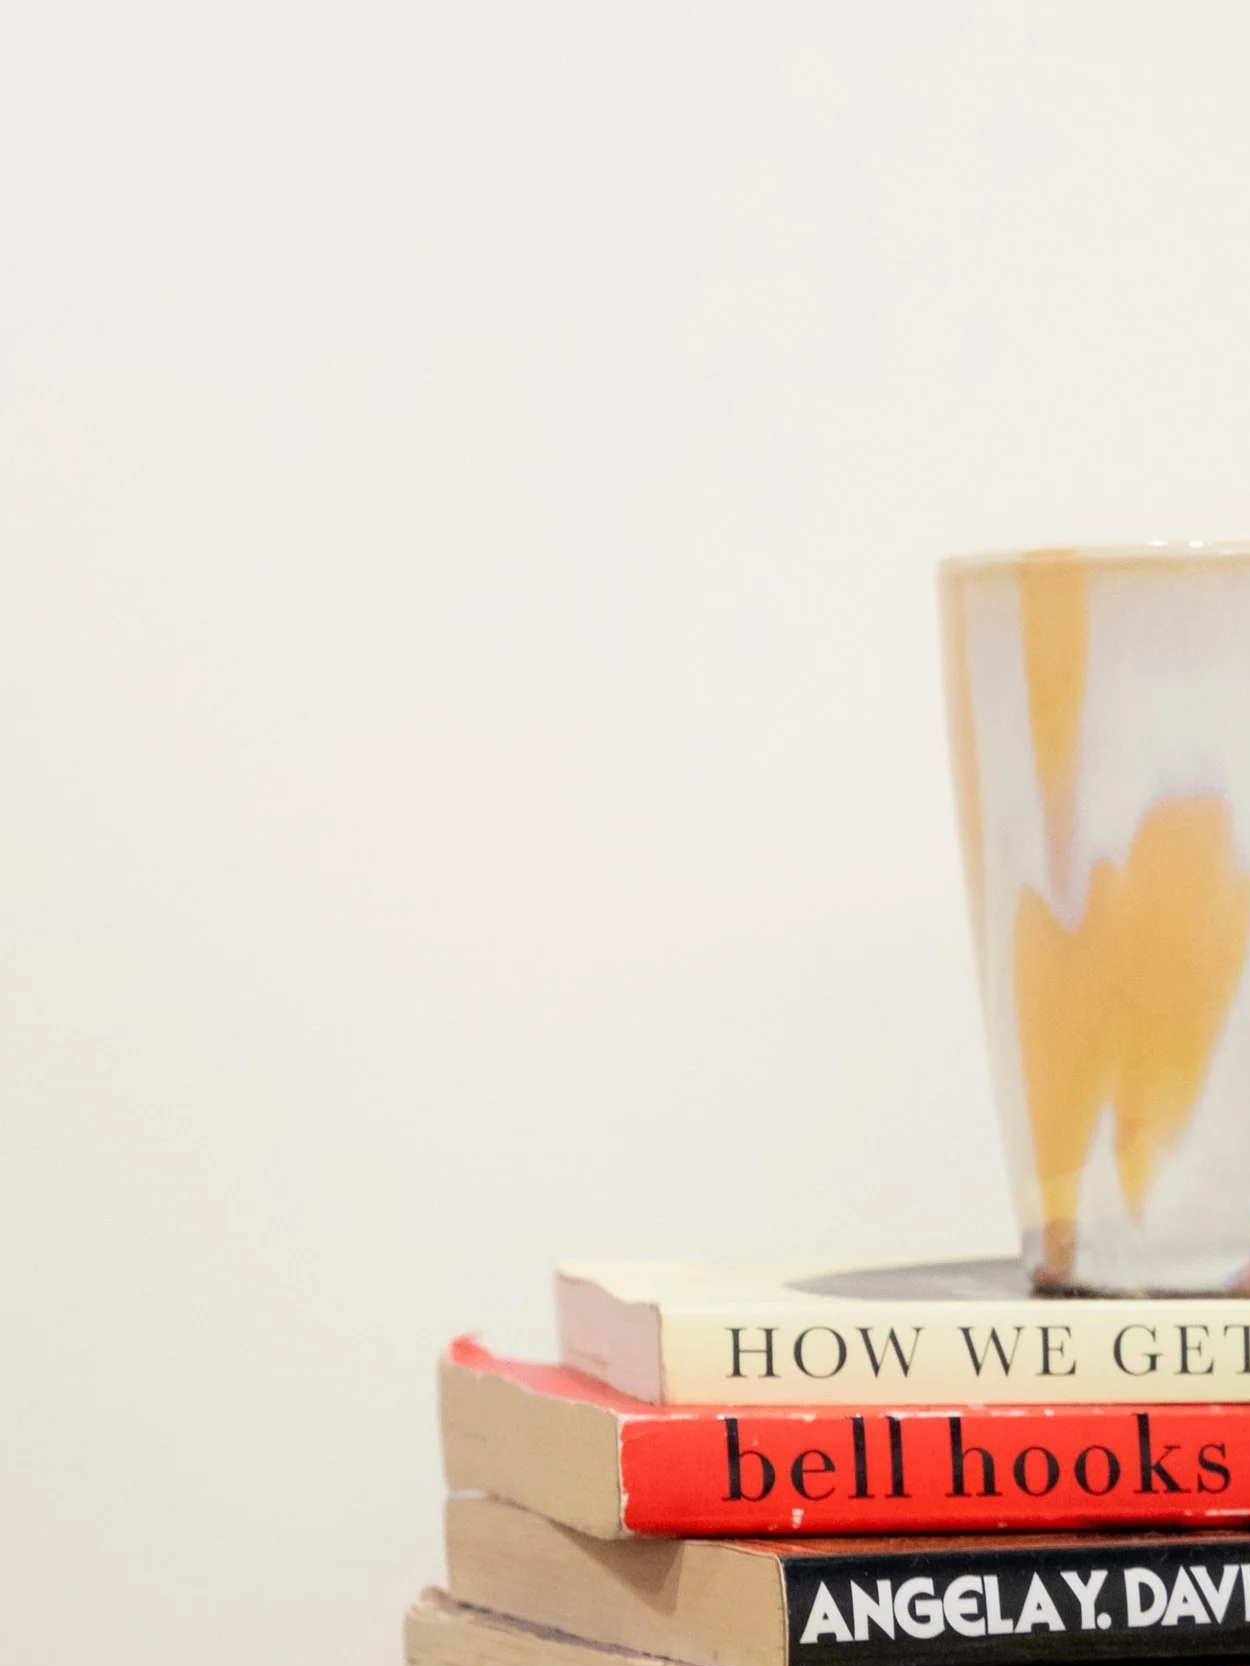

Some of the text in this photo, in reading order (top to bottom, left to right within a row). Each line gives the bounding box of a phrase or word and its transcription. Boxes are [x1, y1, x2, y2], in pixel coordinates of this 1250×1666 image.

[725, 1325, 925, 1380] HOW
[961, 1325, 1076, 1377] WE
[722, 1412, 1232, 1502] bell hooks
